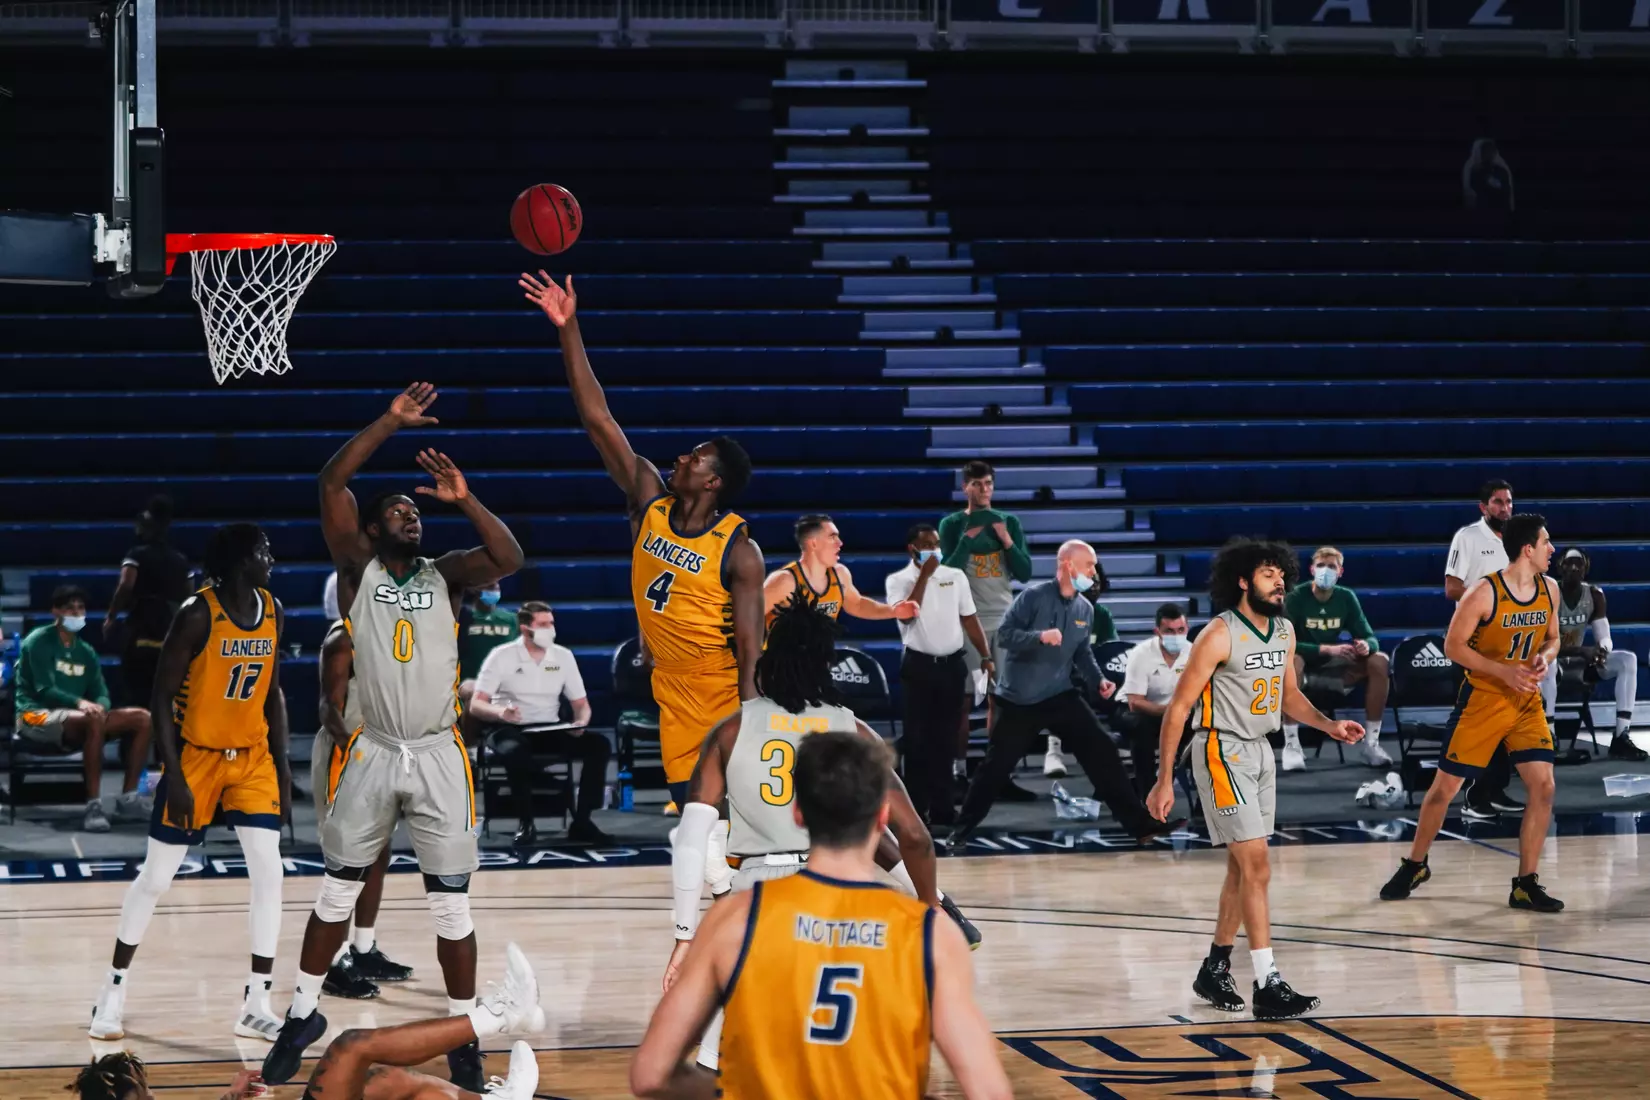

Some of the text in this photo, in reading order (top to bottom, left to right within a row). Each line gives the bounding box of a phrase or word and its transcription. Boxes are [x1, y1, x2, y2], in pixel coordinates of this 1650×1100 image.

[642, 530, 707, 575] LANCERS
[374, 584, 433, 612] SLU
[645, 570, 676, 613] 4
[468, 625, 510, 636] SLU
[1305, 618, 1340, 630] SLU
[1501, 610, 1547, 629] LANCERS
[1560, 614, 1586, 626] SLU
[221, 638, 273, 657] LANCERS
[393, 618, 415, 663] 0
[1505, 629, 1536, 660] 11
[1244, 650, 1285, 670] SLU
[1411, 656, 1453, 667] adidas
[224, 662, 264, 701] 12
[1250, 676, 1280, 715] 25
[760, 739, 796, 806] 3
[795, 913, 888, 949] NOTTAGE
[804, 963, 864, 1046] 5
